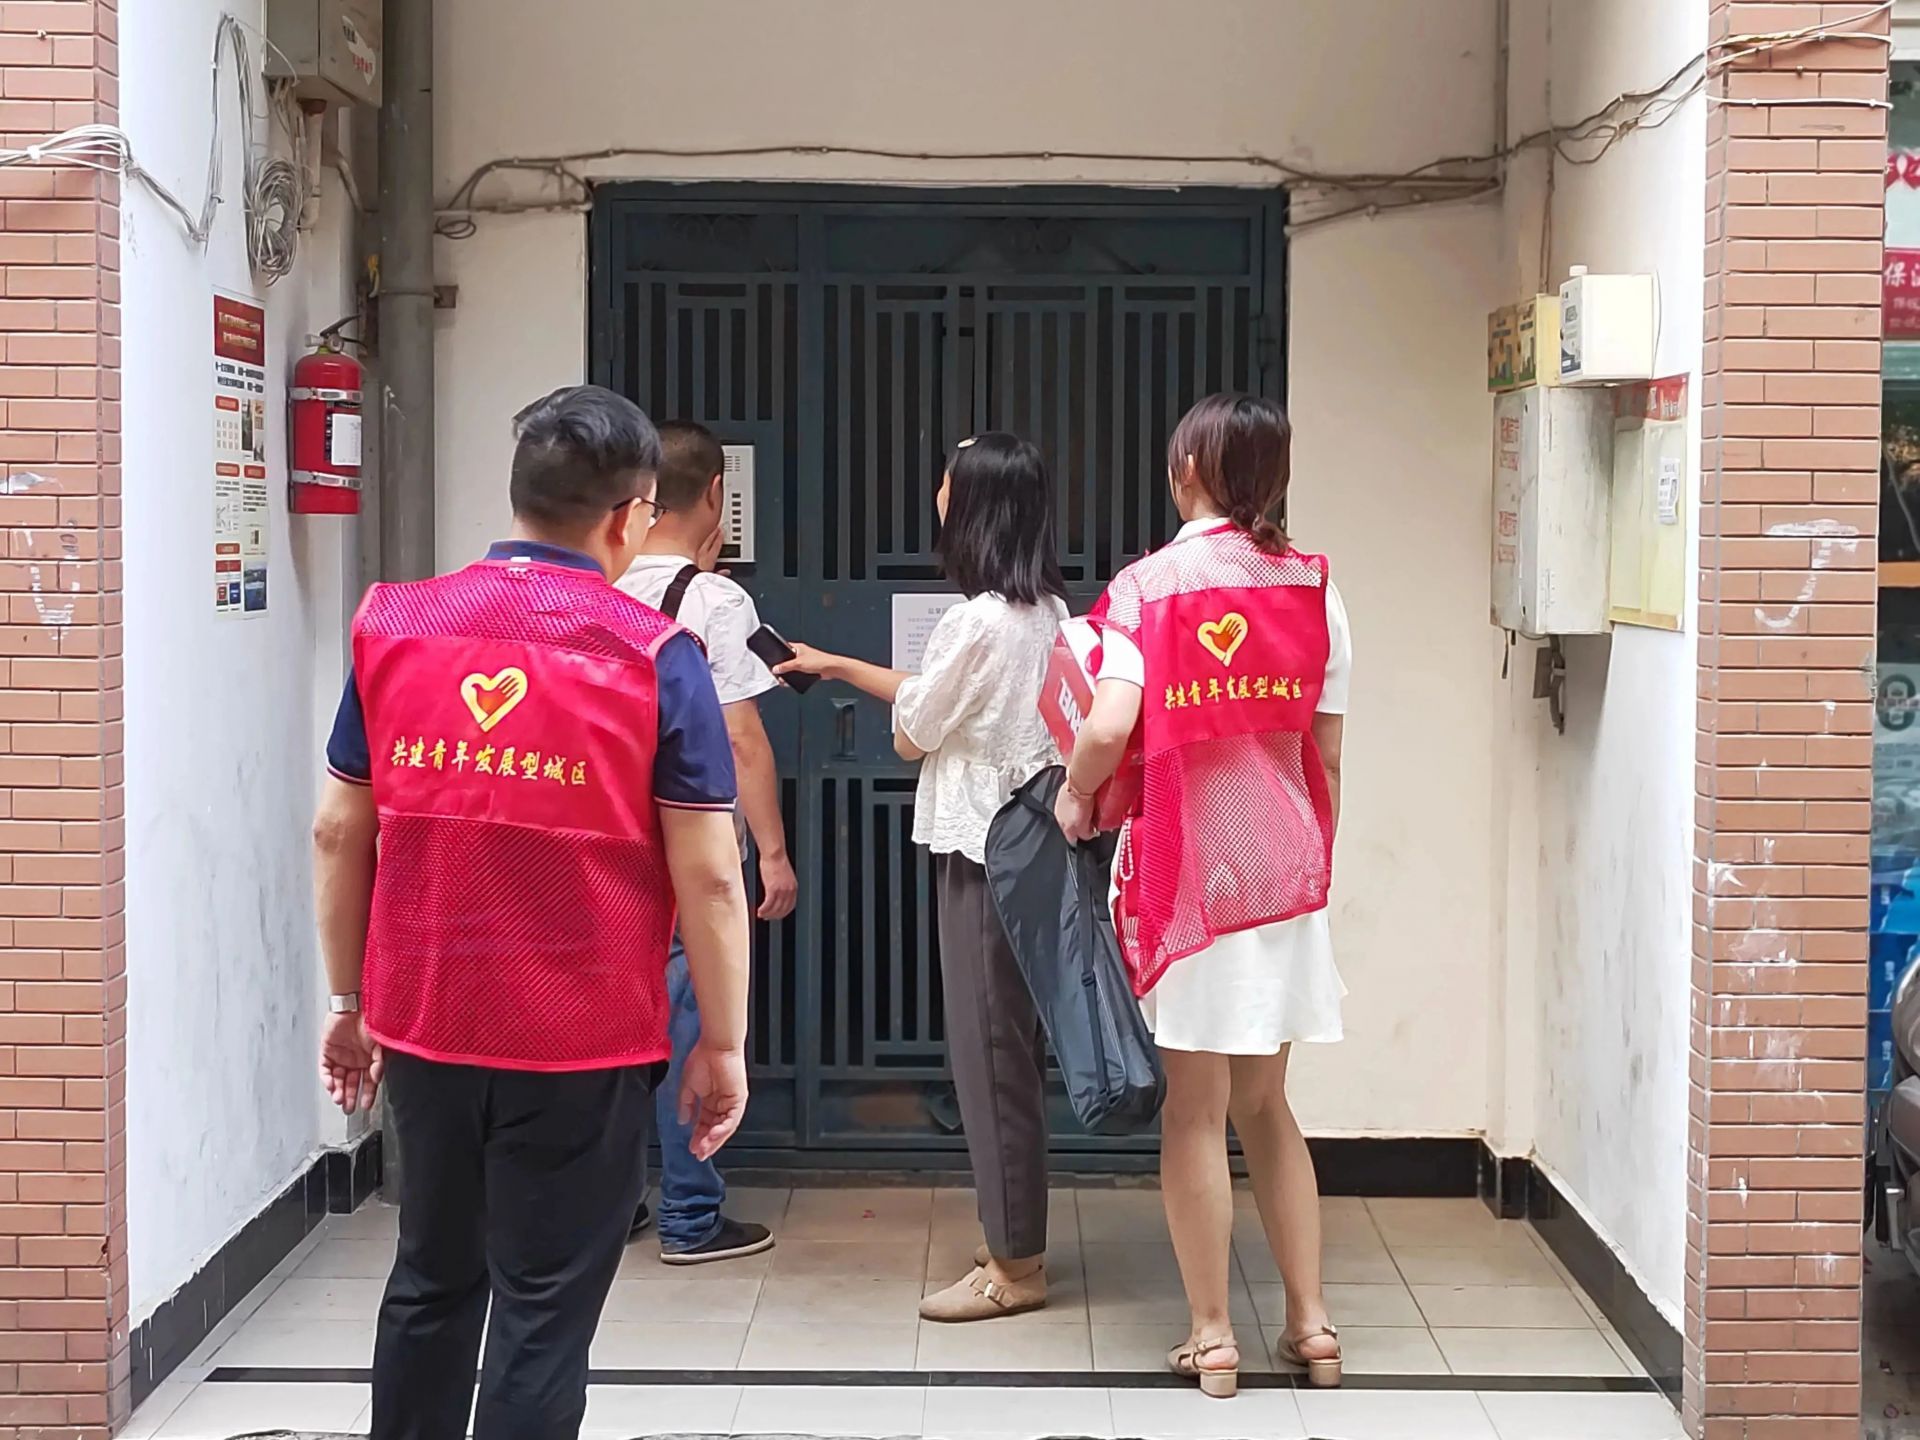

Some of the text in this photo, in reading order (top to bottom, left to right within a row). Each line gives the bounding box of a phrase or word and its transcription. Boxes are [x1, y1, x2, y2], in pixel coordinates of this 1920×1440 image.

[390, 735, 587, 786] 共建青年发展型城区
